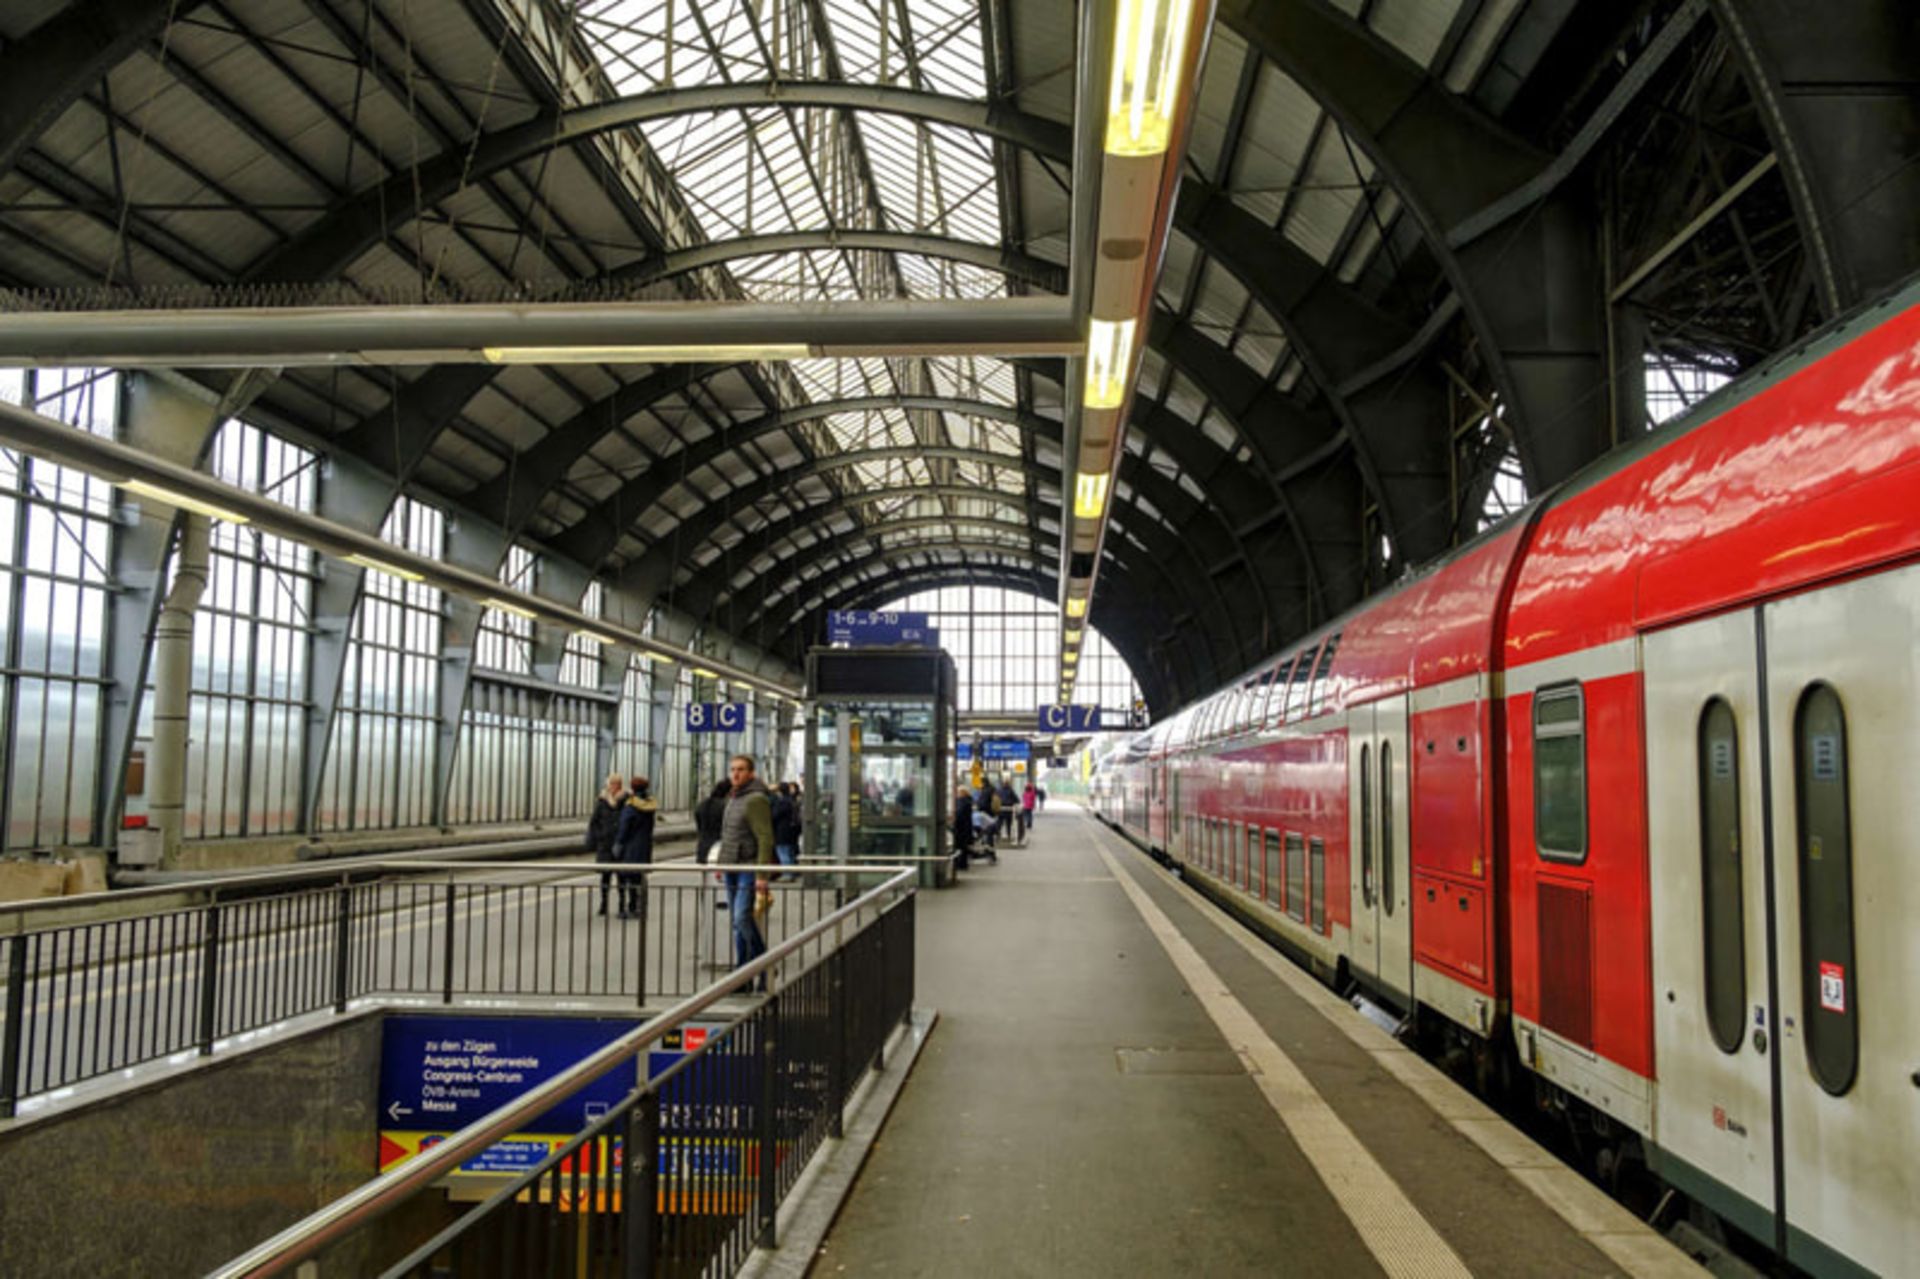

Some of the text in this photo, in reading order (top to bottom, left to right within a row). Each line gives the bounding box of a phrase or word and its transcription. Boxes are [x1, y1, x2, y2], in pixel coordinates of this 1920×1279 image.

[833, 611, 856, 625] 1-6
[868, 611, 899, 625] 9-10
[689, 703, 737, 727] 8 C
[1047, 703, 1096, 728] C 7
[440, 1039, 461, 1052] den
[462, 1038, 497, 1054] Zügen
[423, 1055, 539, 1070] Ausgang Bürgerweide
[422, 1068, 524, 1084] Congress-Centrum
[421, 1099, 457, 1112] Messe
